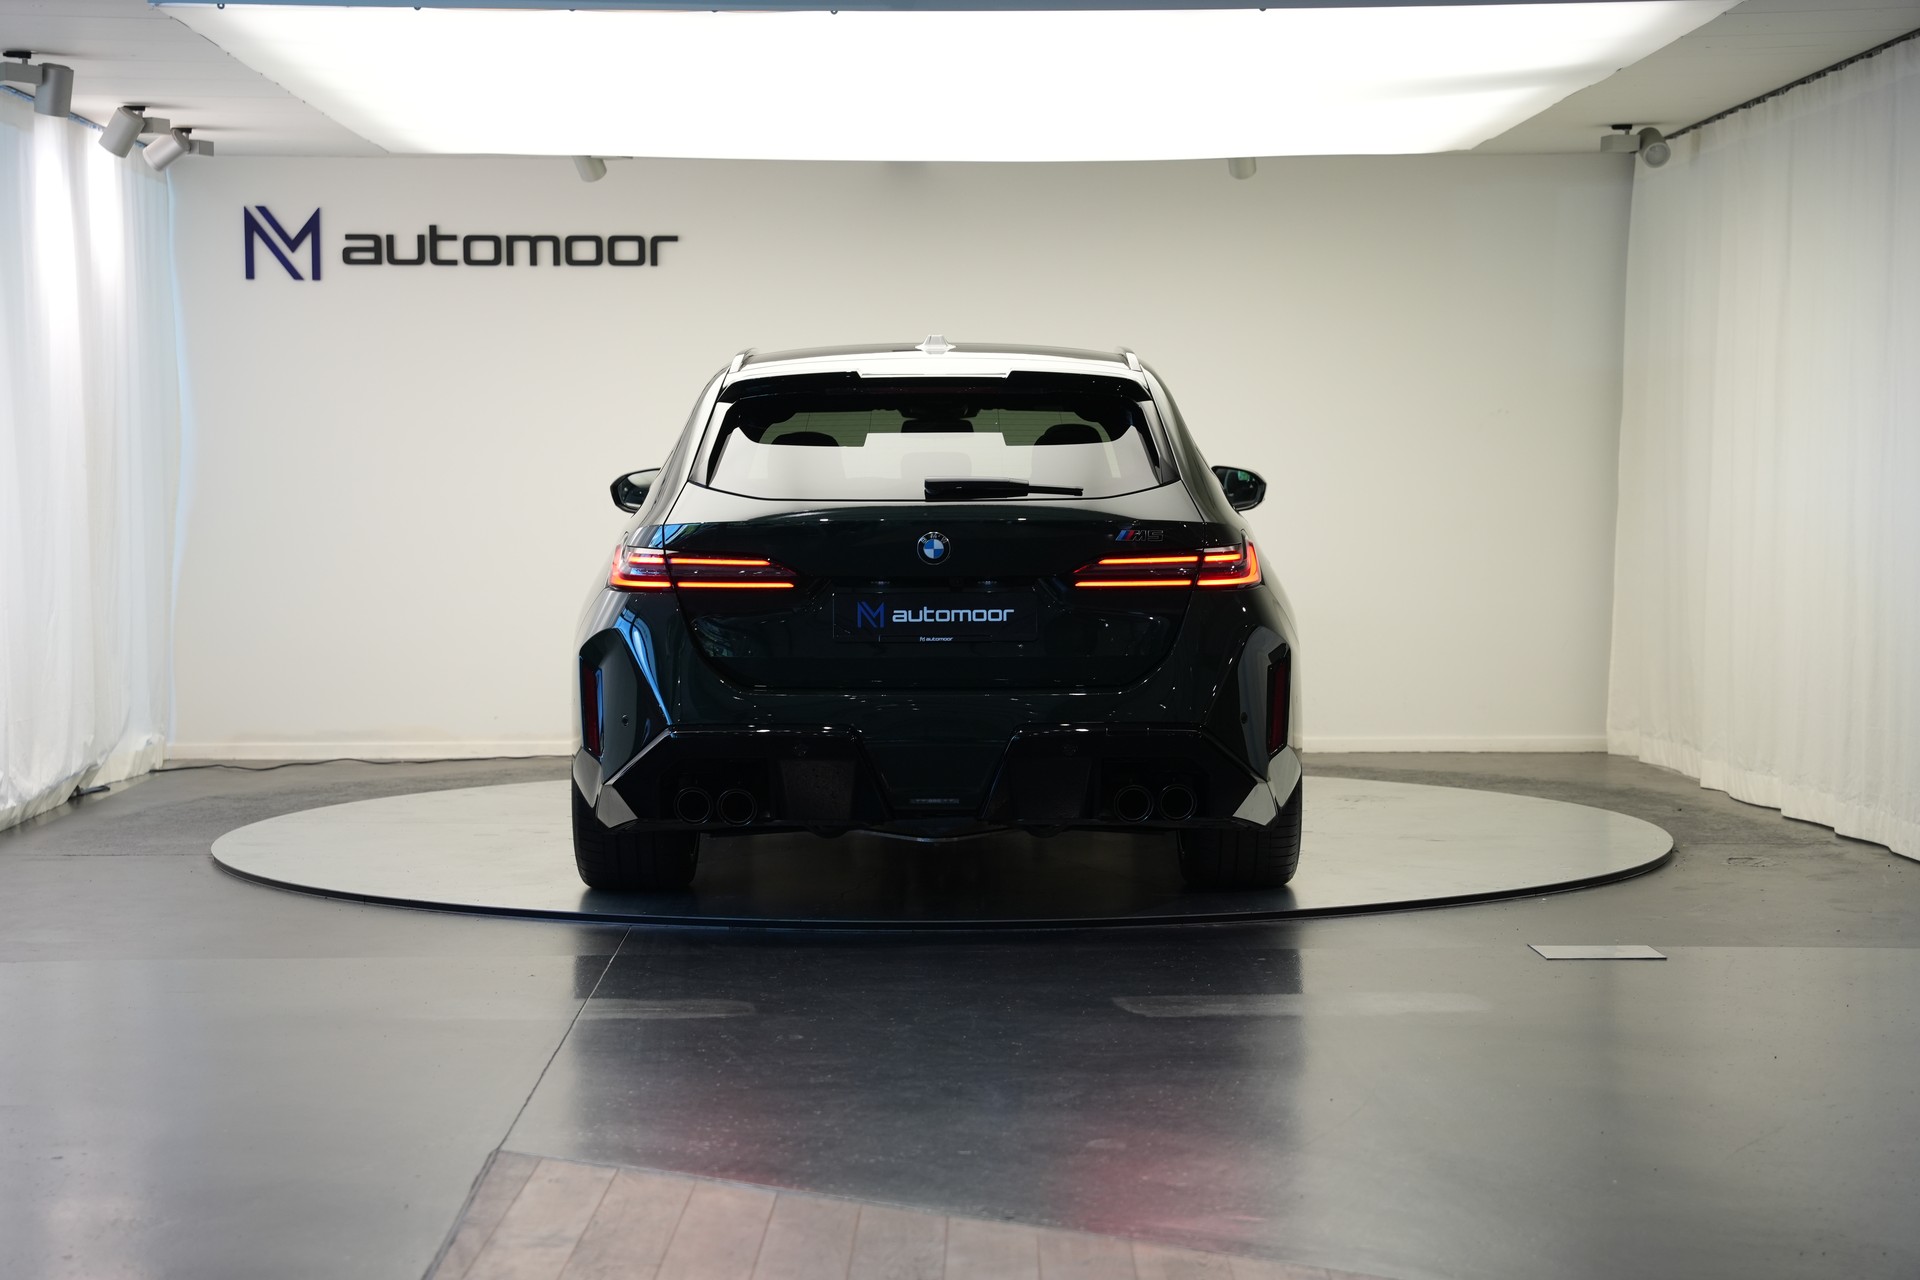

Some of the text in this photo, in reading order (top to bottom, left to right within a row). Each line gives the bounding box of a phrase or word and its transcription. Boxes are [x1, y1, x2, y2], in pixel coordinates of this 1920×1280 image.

[342, 224, 679, 267] automoor
[1128, 529, 1164, 543] M5
[892, 606, 1015, 623] automoor
